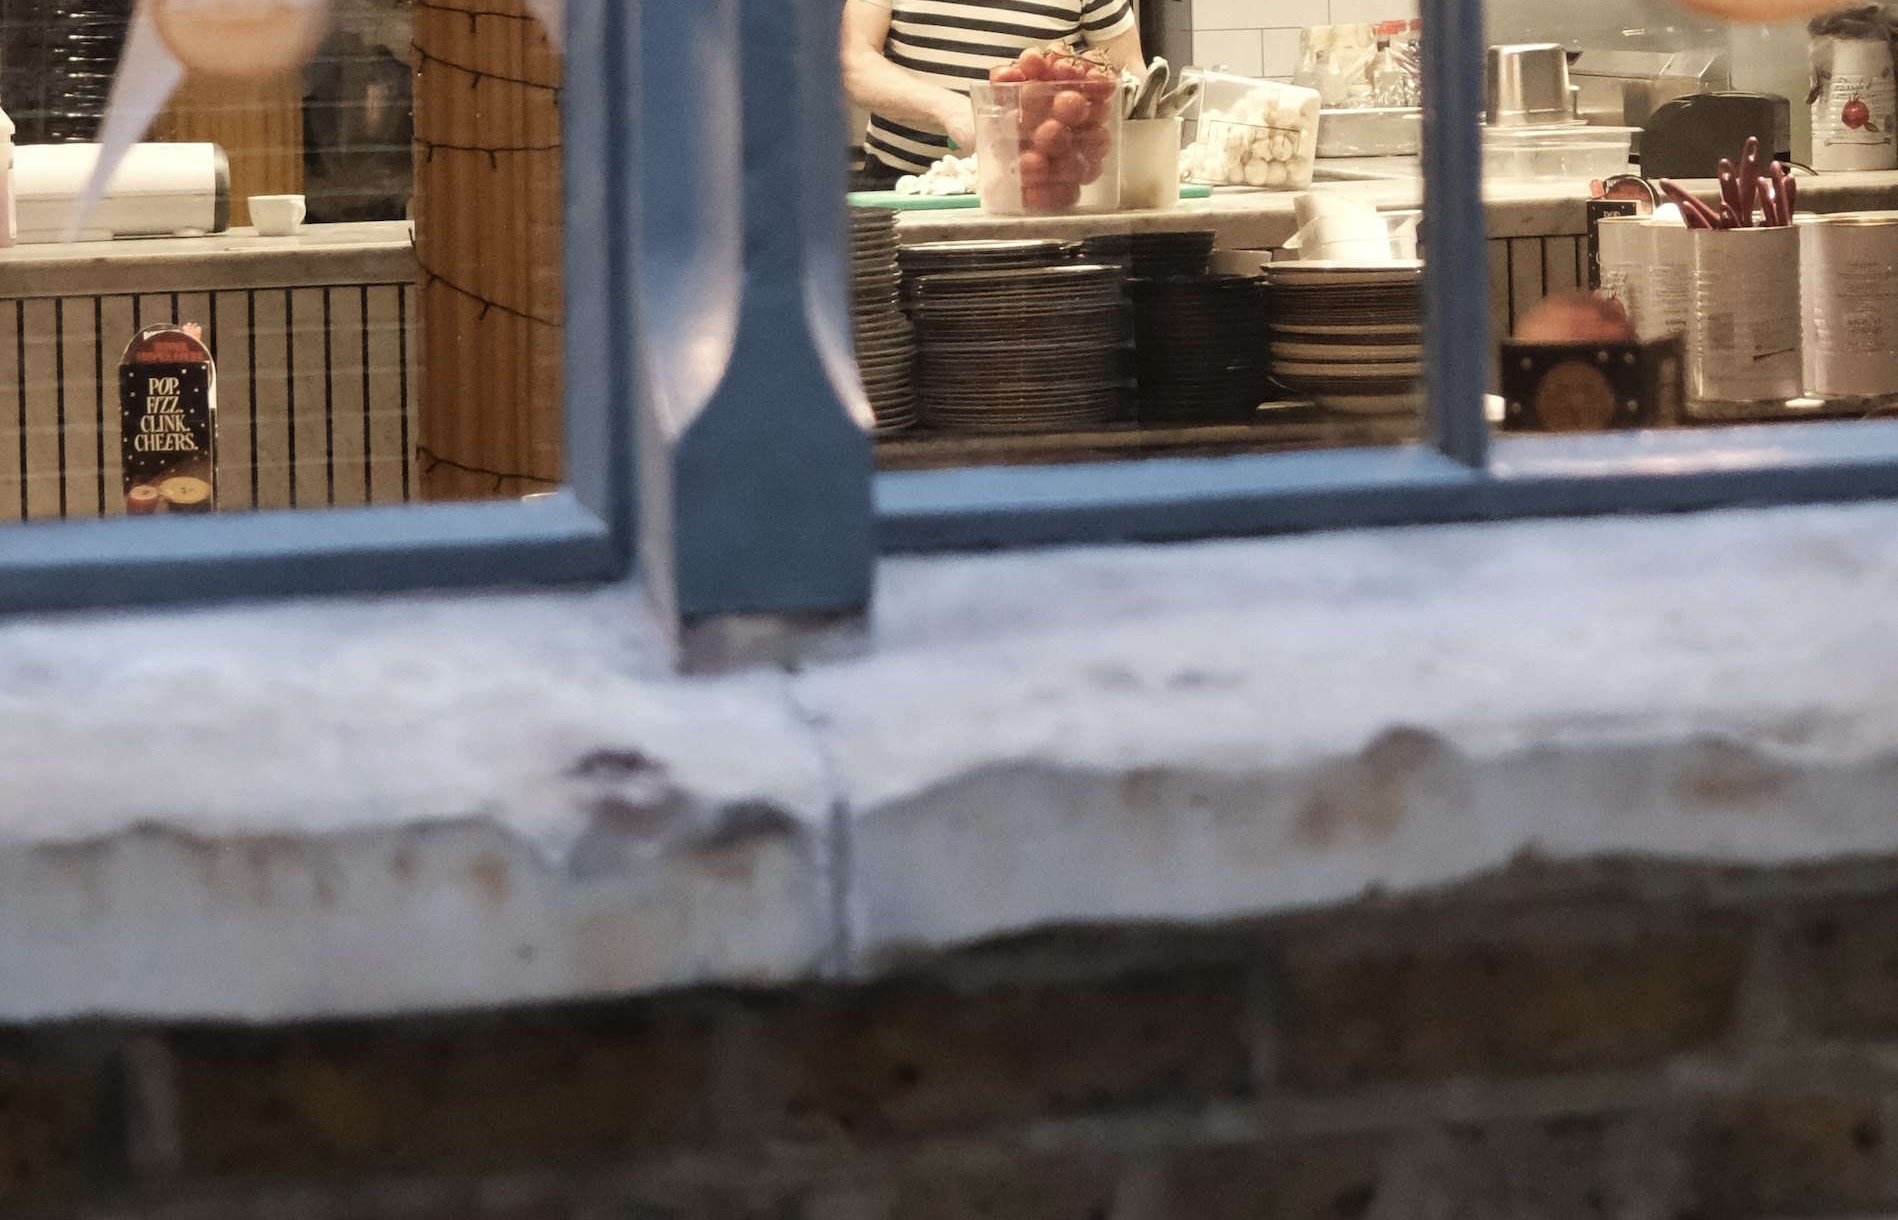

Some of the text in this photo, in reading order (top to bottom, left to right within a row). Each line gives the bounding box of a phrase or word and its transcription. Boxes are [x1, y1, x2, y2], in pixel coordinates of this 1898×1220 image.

[149, 377, 180, 395] POP.
[146, 396, 184, 414] FIZZ.
[140, 414, 190, 432] CLINK.
[134, 433, 198, 451] CHEERS.
